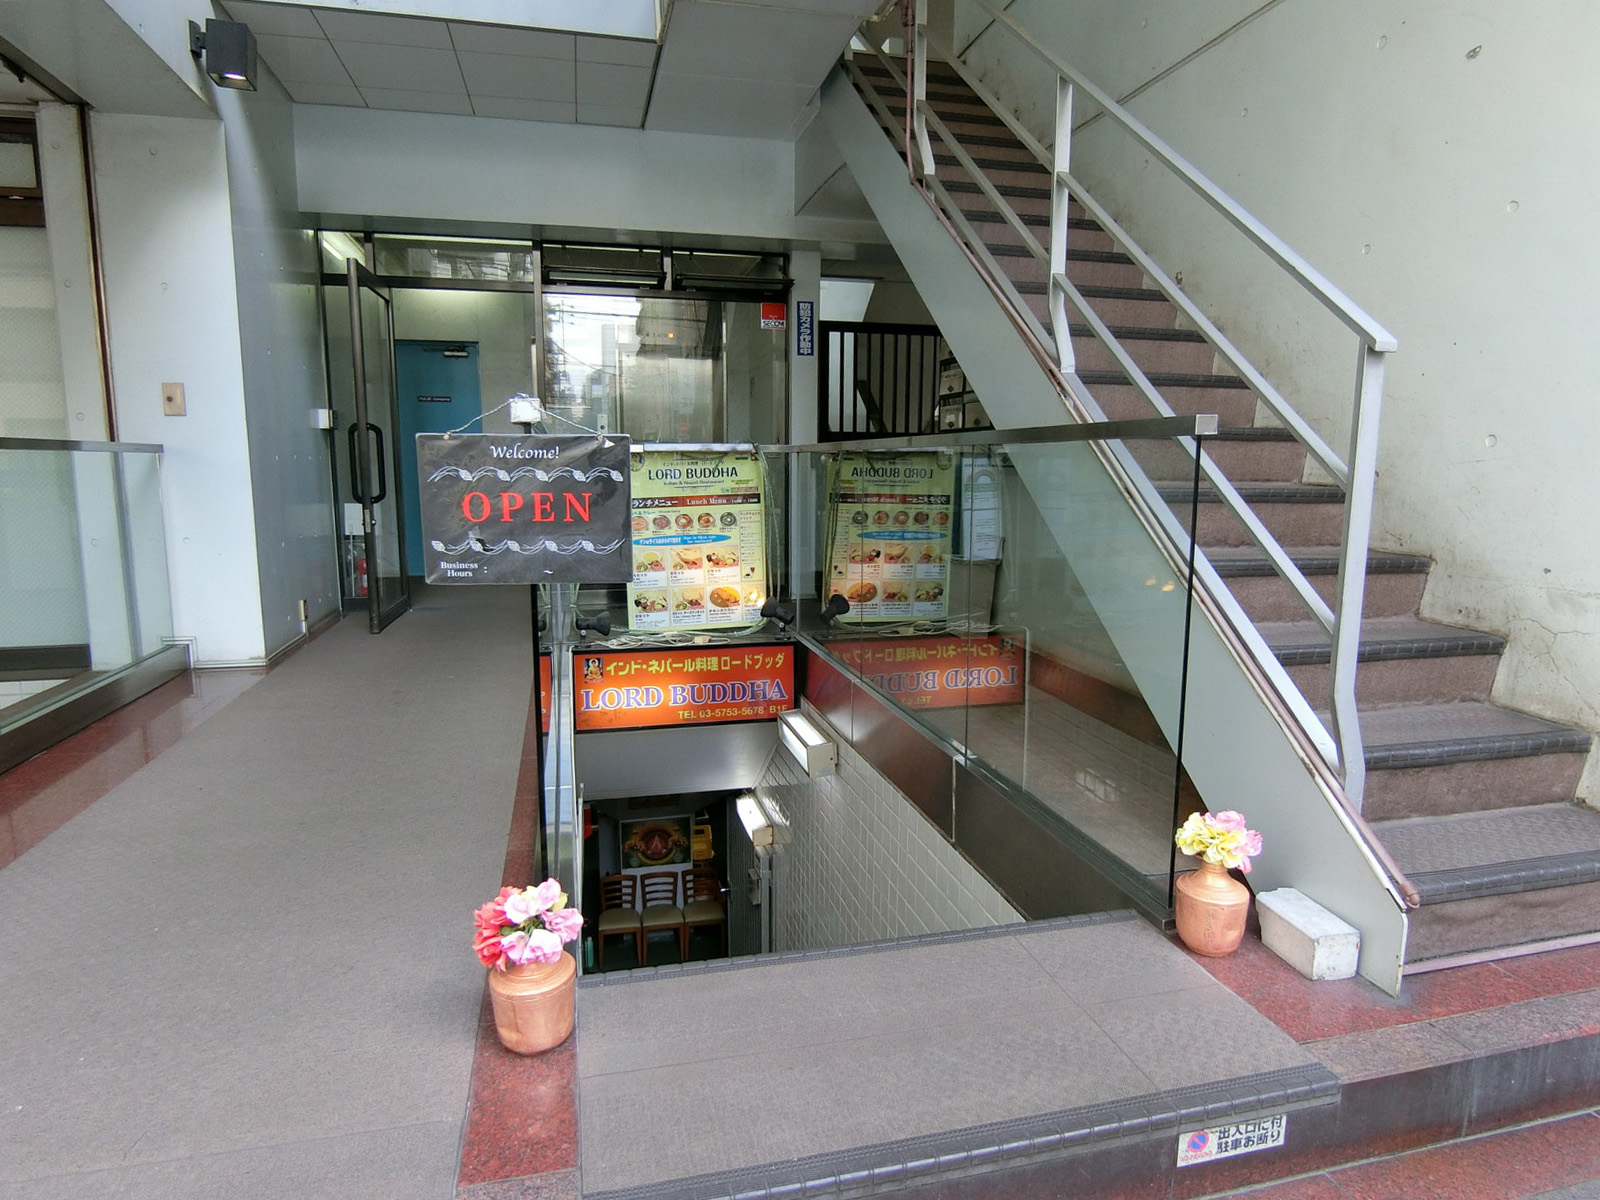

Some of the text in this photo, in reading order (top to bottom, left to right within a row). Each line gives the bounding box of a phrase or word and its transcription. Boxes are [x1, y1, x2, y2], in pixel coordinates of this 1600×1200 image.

[490, 442, 560, 460] Welcome!
[648, 466, 738, 480] LORD BUDDHA
[461, 491, 592, 523] OPEN
[632, 498, 679, 509] ランチメニュー
[440, 561, 479, 570] Business
[447, 568, 473, 577] Hours
[606, 652, 785, 676] インド・ネパール料理ロードブッダ
[581, 679, 787, 711] LORD BUDDHA
[678, 711, 697, 719] TEL
[700, 706, 764, 719] 03-5753-5678
[1218, 1116, 1283, 1140] 出入口に付
[1216, 1131, 1281, 1154] 駐車お断り
